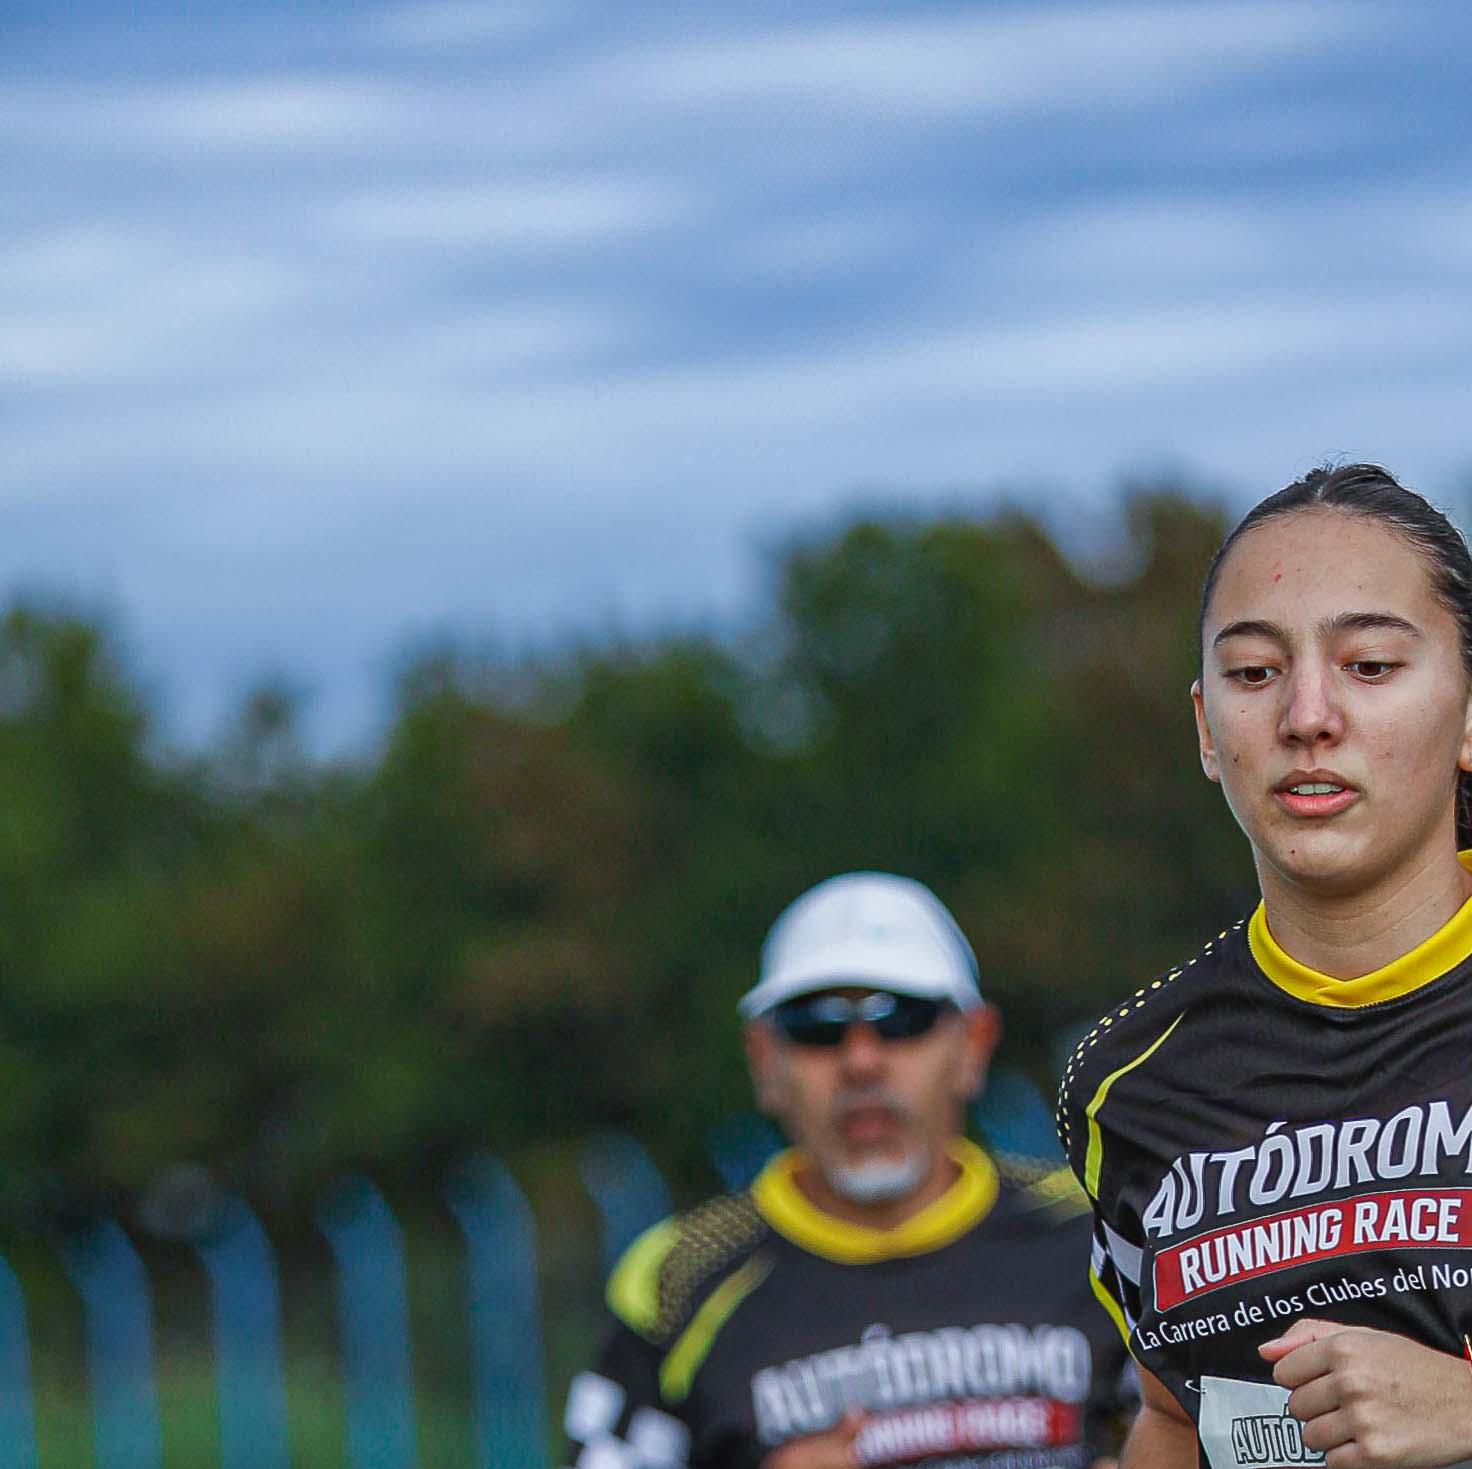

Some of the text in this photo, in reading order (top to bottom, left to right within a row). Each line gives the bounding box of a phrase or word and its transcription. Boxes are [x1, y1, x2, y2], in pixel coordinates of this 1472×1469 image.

[1179, 1198, 1462, 1294] RUNNING RACE
[1136, 1328, 1161, 1350] La
[1160, 1312, 1231, 1345] Carrera
[1234, 1302, 1265, 1327] de
[1265, 1295, 1304, 1318] los
[1306, 1277, 1387, 1306] Clubes
[1393, 1266, 1427, 1292] del
